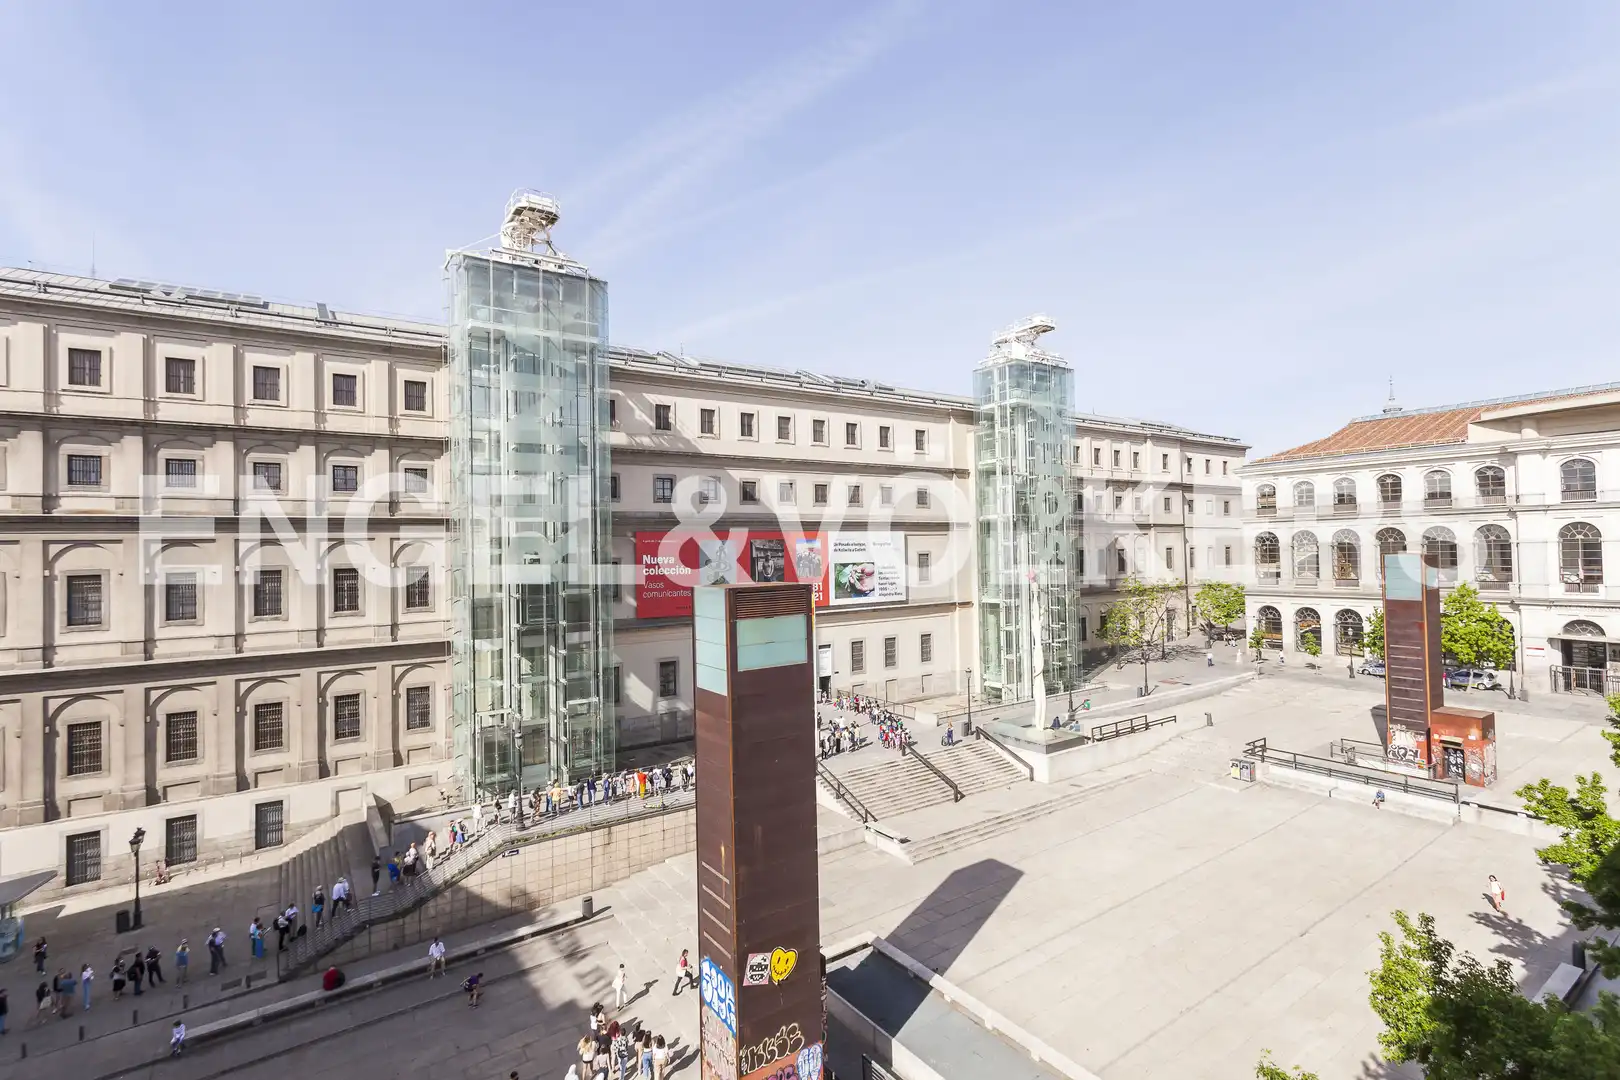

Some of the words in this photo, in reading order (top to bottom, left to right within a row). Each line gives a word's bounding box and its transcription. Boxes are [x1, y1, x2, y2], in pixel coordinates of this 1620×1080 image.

[643, 554, 674, 564] Nueva
[643, 565, 691, 575] colección
[643, 581, 664, 589] Vasos
[643, 589, 691, 598] comunicantes
